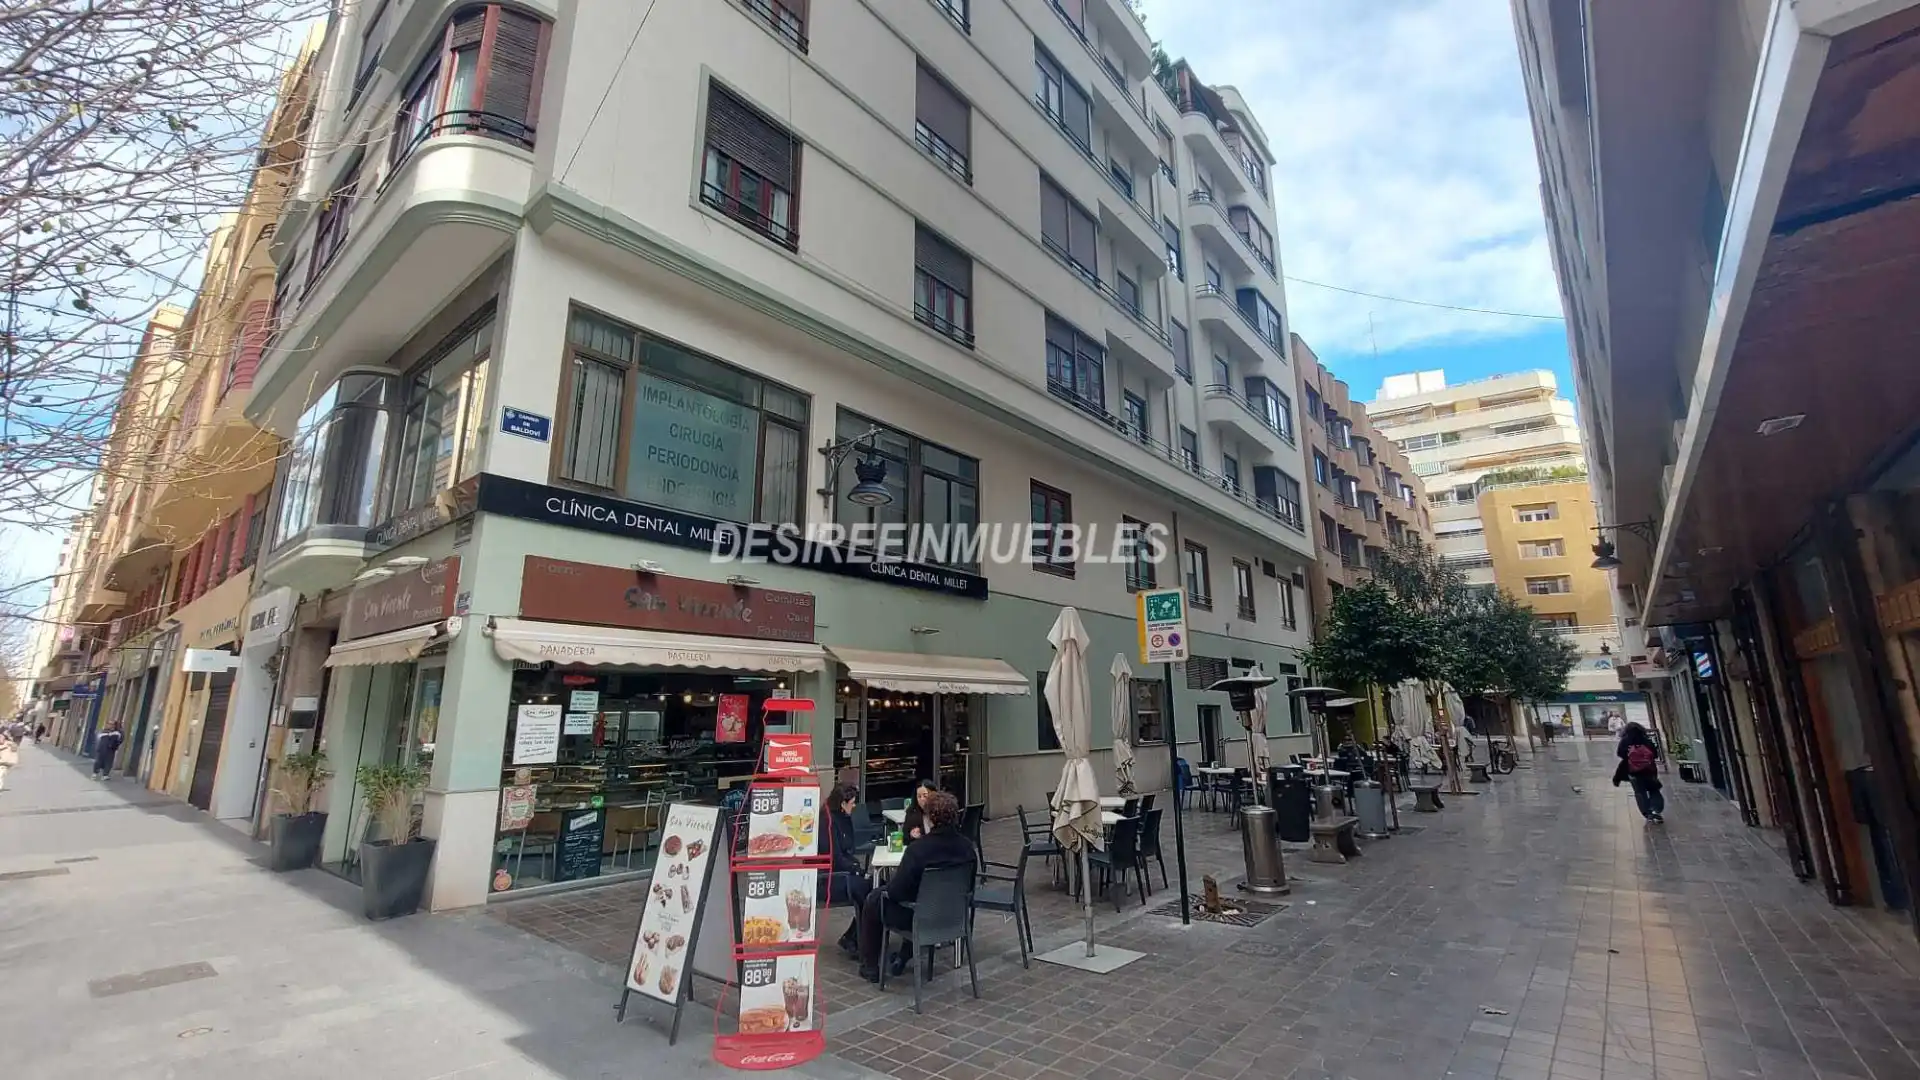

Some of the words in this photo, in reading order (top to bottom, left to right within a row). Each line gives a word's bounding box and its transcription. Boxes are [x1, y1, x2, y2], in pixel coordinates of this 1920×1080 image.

[669, 422, 724, 452] CIRUGÍA
[648, 445, 740, 483] PERIODONCIA
[546, 496, 618, 524] CLÍNICA
[625, 512, 682, 536] DENTAL
[690, 525, 732, 545] MILLET
[870, 560, 907, 579] CLÍNICA
[909, 568, 940, 586] DENTAL
[944, 575, 968, 590] MILLET
